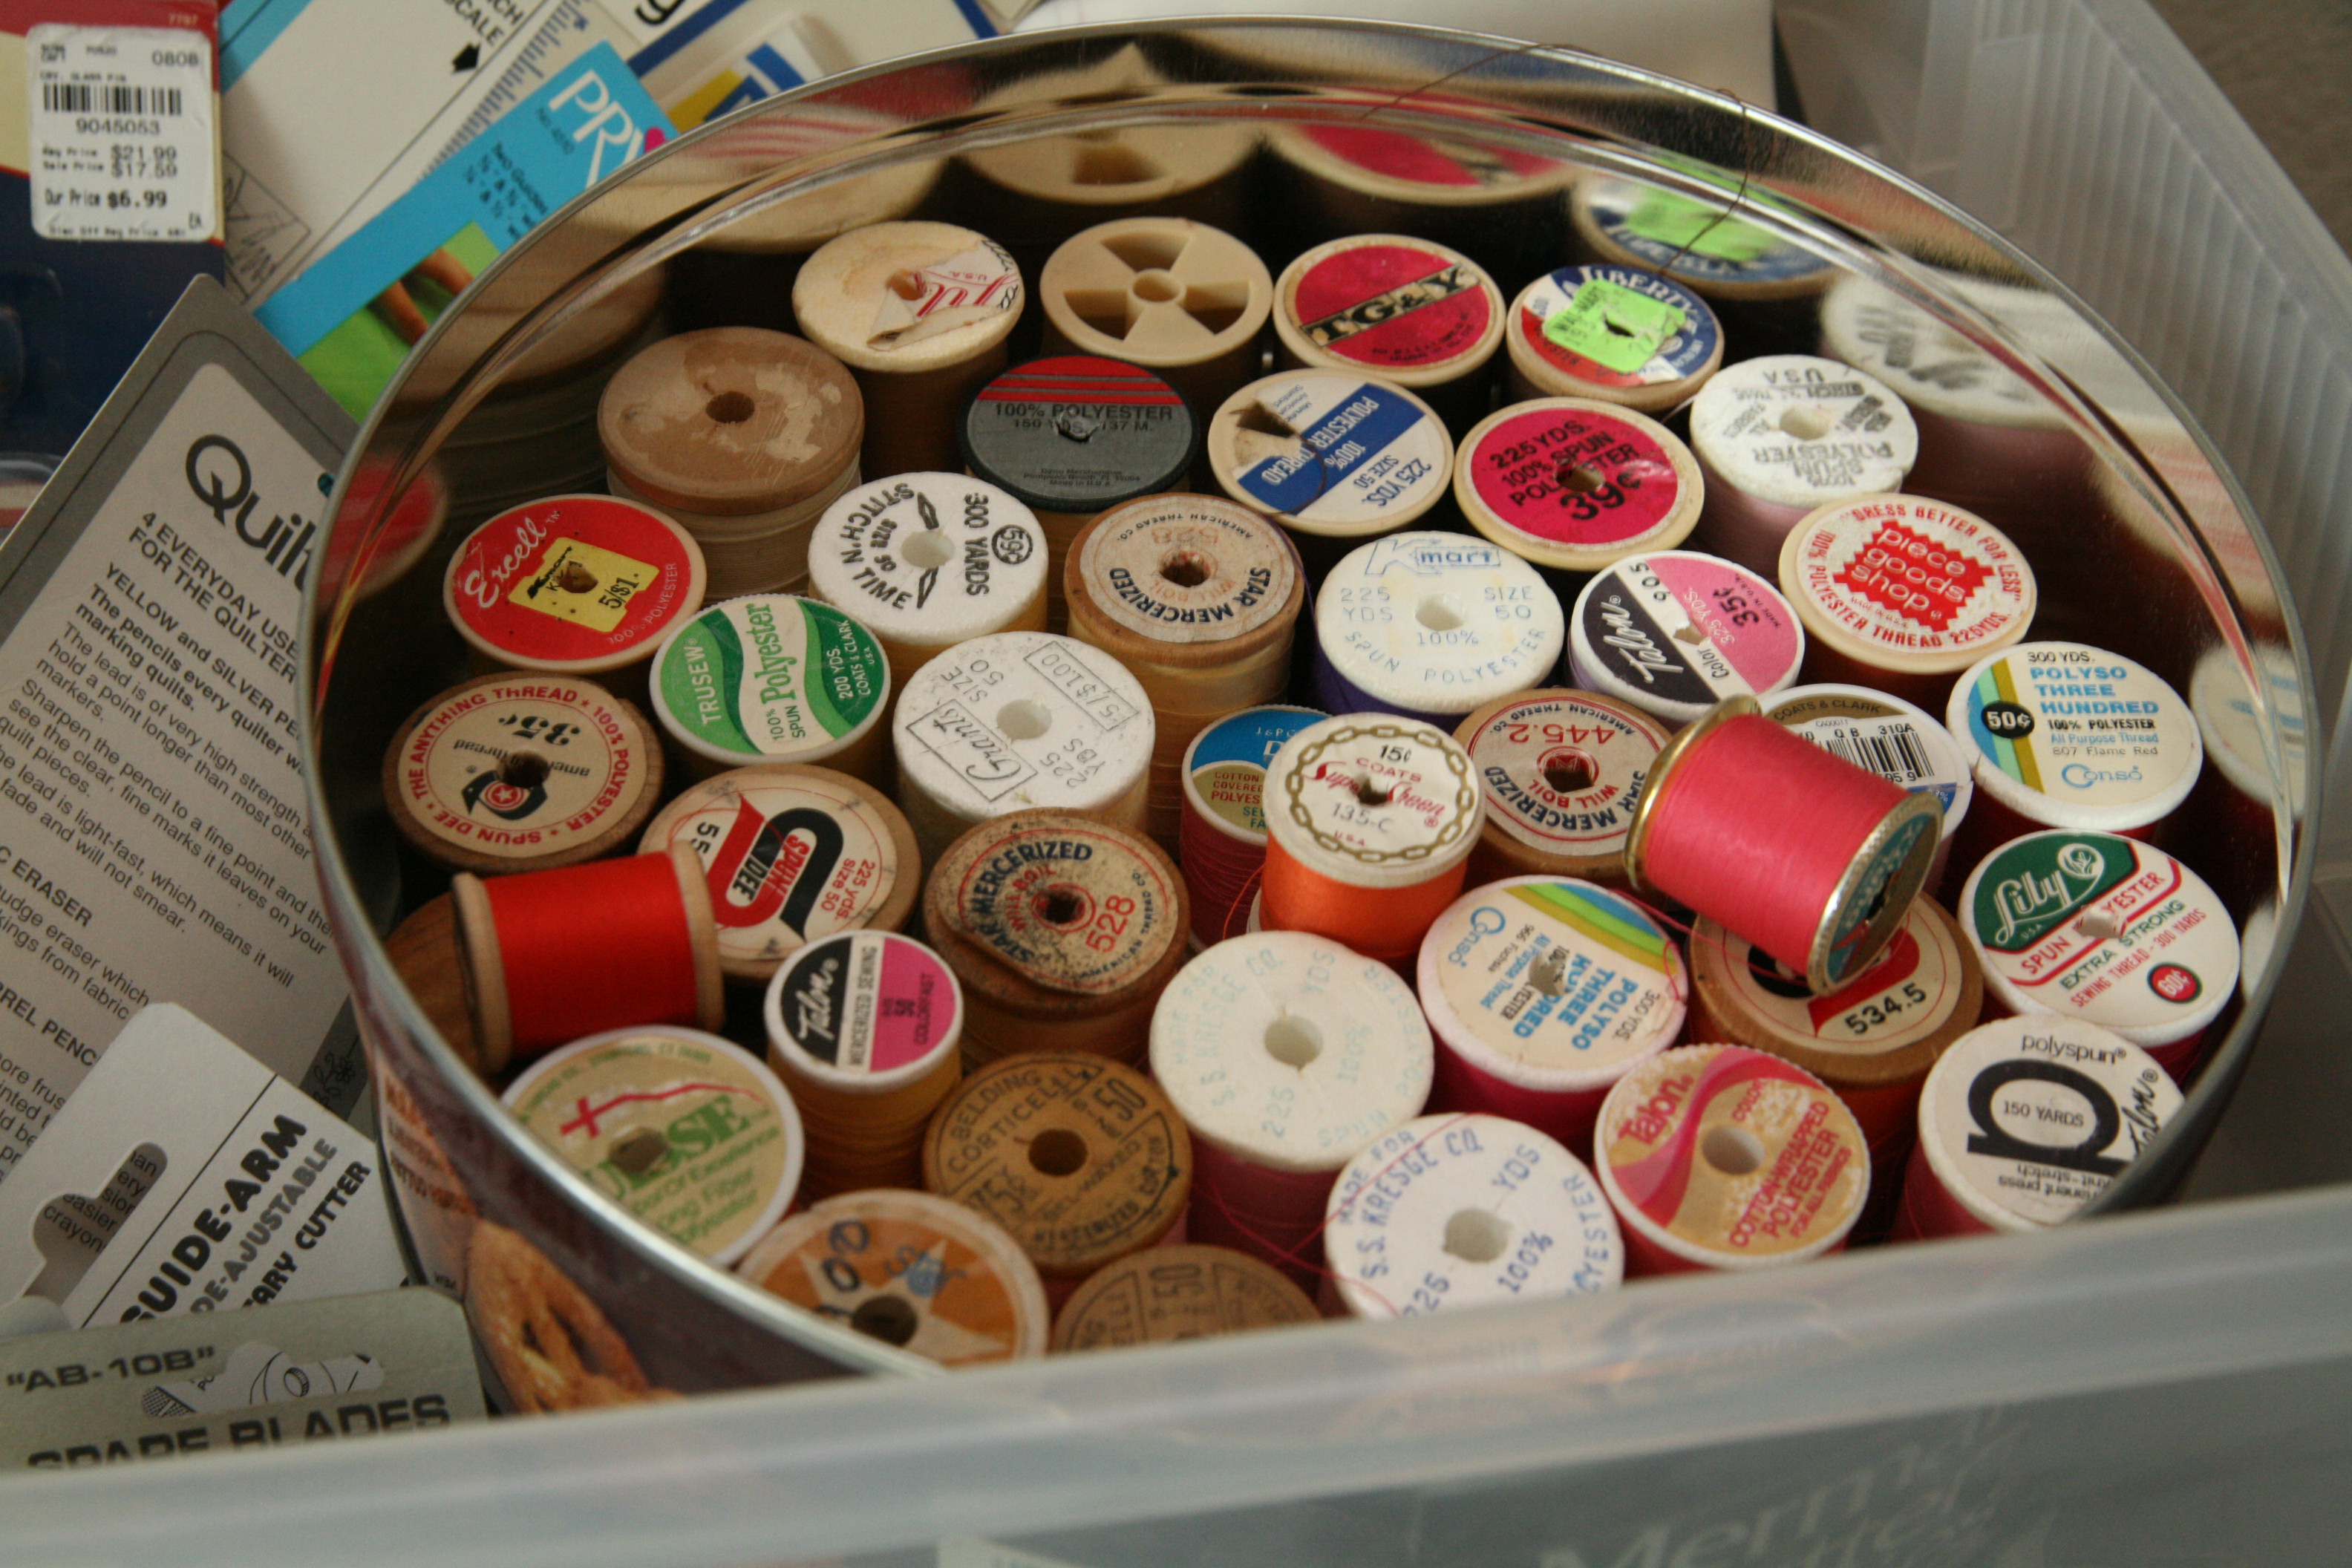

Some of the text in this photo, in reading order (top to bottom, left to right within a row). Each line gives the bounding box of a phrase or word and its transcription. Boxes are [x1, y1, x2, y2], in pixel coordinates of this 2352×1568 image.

[152, 50, 198, 67] 0808
[76, 118, 160, 134] 9045053
[111, 145, 177, 162] $21.99
[45, 189, 167, 209] Our Price $6.99
[996, 403, 1172, 420] 100% POLYESTER
[1307, 396, 1379, 451] POLYESTER
[1324, 440, 1367, 471] 100%
[1353, 454, 1399, 489] SIZE 50
[1396, 457, 1432, 485] 225
[1489, 441, 1538, 469] 225
[1501, 430, 1616, 487] 100% SPUN
[1753, 442, 1894, 464] POLYESTER
[840, 483, 915, 609] STITCH TIME
[964, 492, 990, 596] 300 YARDS
[1136, 514, 1253, 540] AMERICAN THREAD
[1916, 506, 2008, 559] BETTER FOR
[128, 526, 215, 610] FOR THE
[157, 523, 261, 621] EVERYDAY
[464, 517, 547, 609] Excell
[1863, 548, 1965, 602] goods
[1878, 528, 1966, 578] piece
[644, 563, 678, 624] POLYESTER
[1109, 566, 1272, 623] STAR MERCERIZED
[1341, 587, 1391, 602] 225
[1485, 586, 1535, 601] SIZE
[1713, 587, 1760, 627] 35¢
[1809, 565, 1942, 647] POLYESTER THREAD
[1852, 565, 1930, 611] shop
[76, 603, 144, 668] marking
[1342, 607, 1394, 622] YDS
[1494, 605, 1532, 620] 50
[89, 584, 231, 713] The pencils every
[105, 562, 274, 714] YELLOW and SILVER
[838, 619, 872, 696] COATS CLARK
[1345, 628, 1546, 683] SPUN POLYESTER
[1417, 631, 1480, 646] 100%
[2028, 651, 2095, 663] 300 YDS.
[683, 646, 722, 725] TRUSEW
[745, 603, 797, 742] 100% Polyester
[941, 659, 1004, 702] SIZE 50
[1041, 653, 1120, 717] 5/$1.00
[1697, 647, 1730, 679] Color
[2030, 667, 2127, 679] POLYSO
[833, 676, 854, 699] 200
[1774, 699, 1881, 721] COATS CLARK
[2034, 684, 2116, 696] THREE
[2040, 701, 2159, 714] HUNDRED
[785, 705, 806, 739] SPUN
[1507, 723, 1616, 745] 445.2
[1510, 703, 1636, 736] AMERICAN THREAD
[1986, 710, 2031, 731] 50¢
[2048, 719, 2155, 731] 100% POLYESTER
[2069, 733, 2159, 745] Purpose Thread
[22, 679, 172, 808] Sharpen pencil
[48, 638, 311, 860] hold point longer than most other
[409, 693, 487, 800] THE ANYTHING
[2053, 746, 2158, 756] 807 Flame Red
[566, 705, 630, 832] 100% POLYESTER
[1040, 752, 1088, 788] 225
[1215, 772, 1260, 783] COTTON
[1356, 757, 1422, 783] COATS
[240, 771, 302, 830] strength
[1485, 765, 1618, 831] MERCERIZED
[1527, 779, 1619, 808] WILL BOIL
[39, 811, 74, 843] and
[434, 811, 542, 845] SPUN DEE
[18, 762, 252, 956] lead which means
[152, 812, 266, 910] marks leaves
[733, 856, 770, 901] DEE
[765, 835, 810, 896] SPUN
[853, 859, 876, 888] 225
[971, 841, 1094, 914] MERCERIZED
[821, 858, 855, 911] size 50
[1993, 870, 2073, 945] Lily
[45, 924, 101, 970] eraser
[1085, 895, 1136, 953] 528
[2059, 899, 2186, 991] EXTRA STRONG
[2021, 936, 2073, 975] SPUN
[2071, 908, 2207, 1007] SEWING THREAD 300 YARDS
[42, 946, 131, 1021] from fabric
[1480, 979, 1513, 1010] Thread
[1558, 967, 1616, 1027] THREE
[2157, 969, 2189, 996] 60¢
[1572, 977, 1639, 1051] POLYSO
[1845, 982, 1927, 1035] 534.5
[2022, 1034, 2117, 1064] polyspun
[2004, 1100, 2085, 1128] 150 YARDS
[1371, 1129, 1415, 1160] FOR
[1492, 1143, 1540, 1191] YDS
[295, 1160, 371, 1250] CUTTER
[1361, 1143, 1438, 1226] KRESGE
[1762, 1128, 1840, 1239] POLYESTER
[1498, 1229, 1553, 1294] 100%
